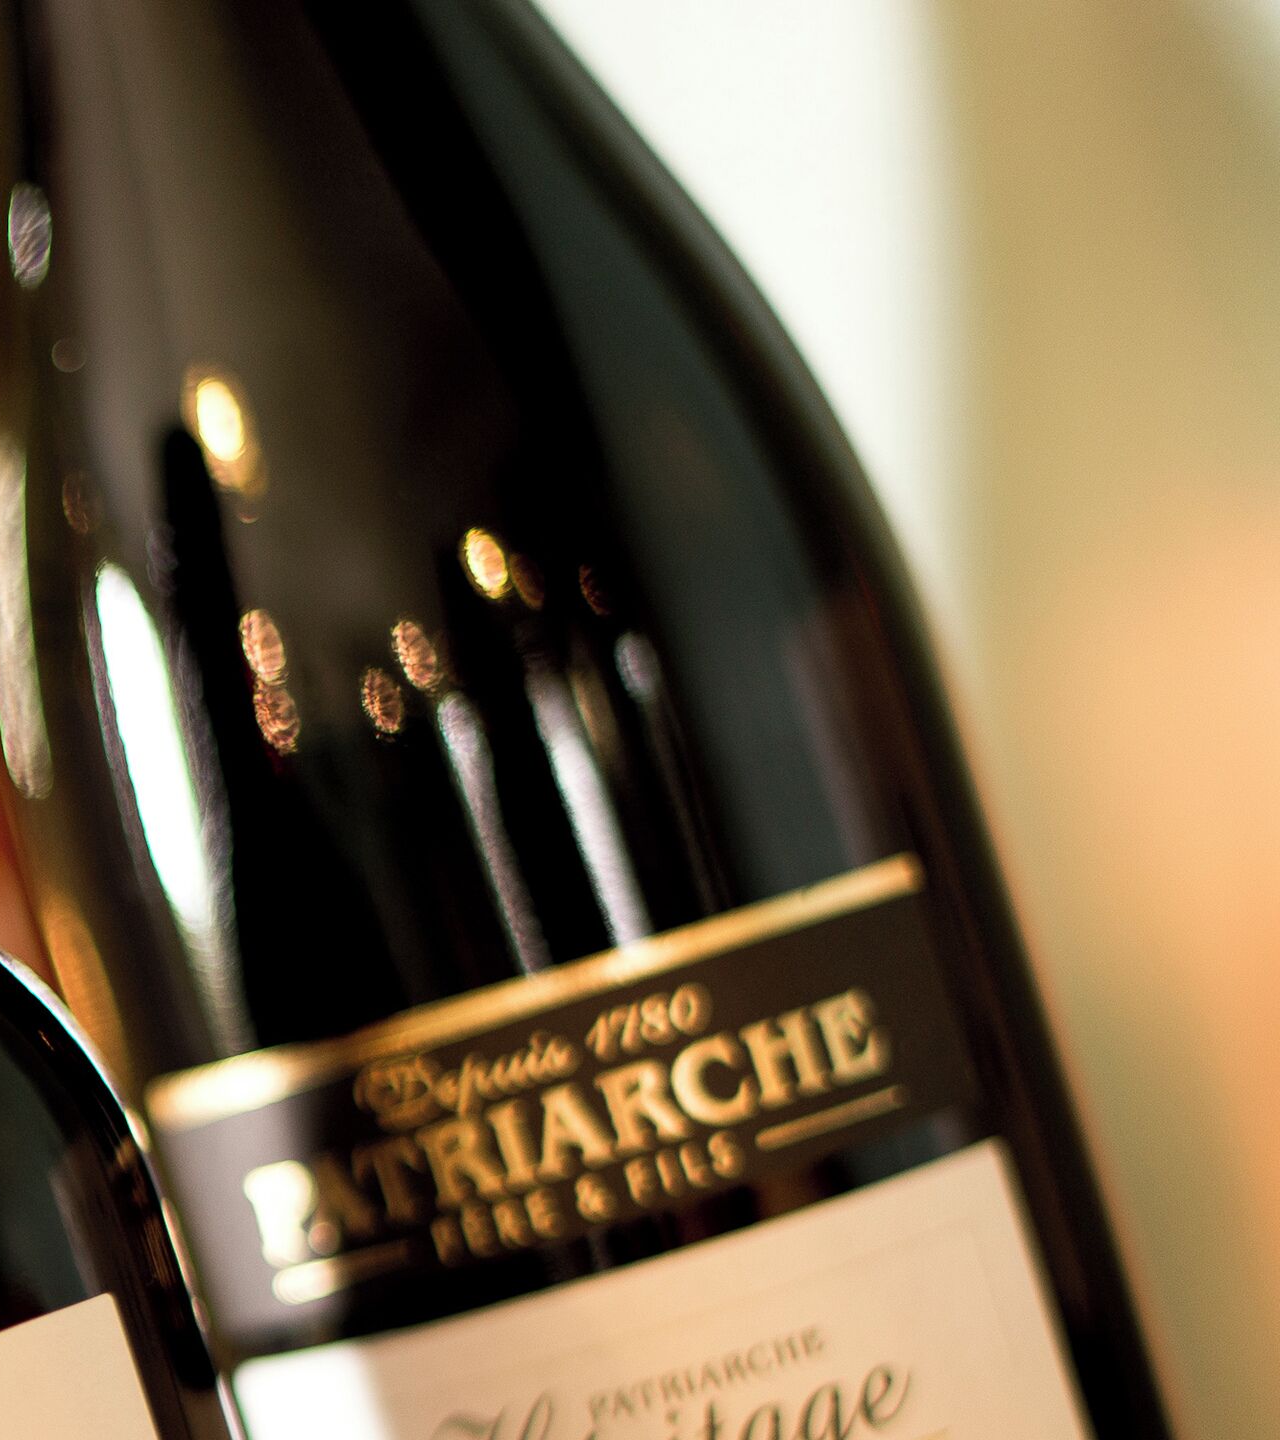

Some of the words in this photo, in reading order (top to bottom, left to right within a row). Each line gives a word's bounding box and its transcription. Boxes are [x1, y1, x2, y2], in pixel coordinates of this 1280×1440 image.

[354, 1030, 579, 1132] Depuis
[586, 983, 709, 1062] 1780
[244, 990, 891, 1268] PATRIARCHE
[575, 1171, 614, 1222] &
[625, 1130, 743, 1206] FILS
[586, 1325, 826, 1426] PATRIARCHE
